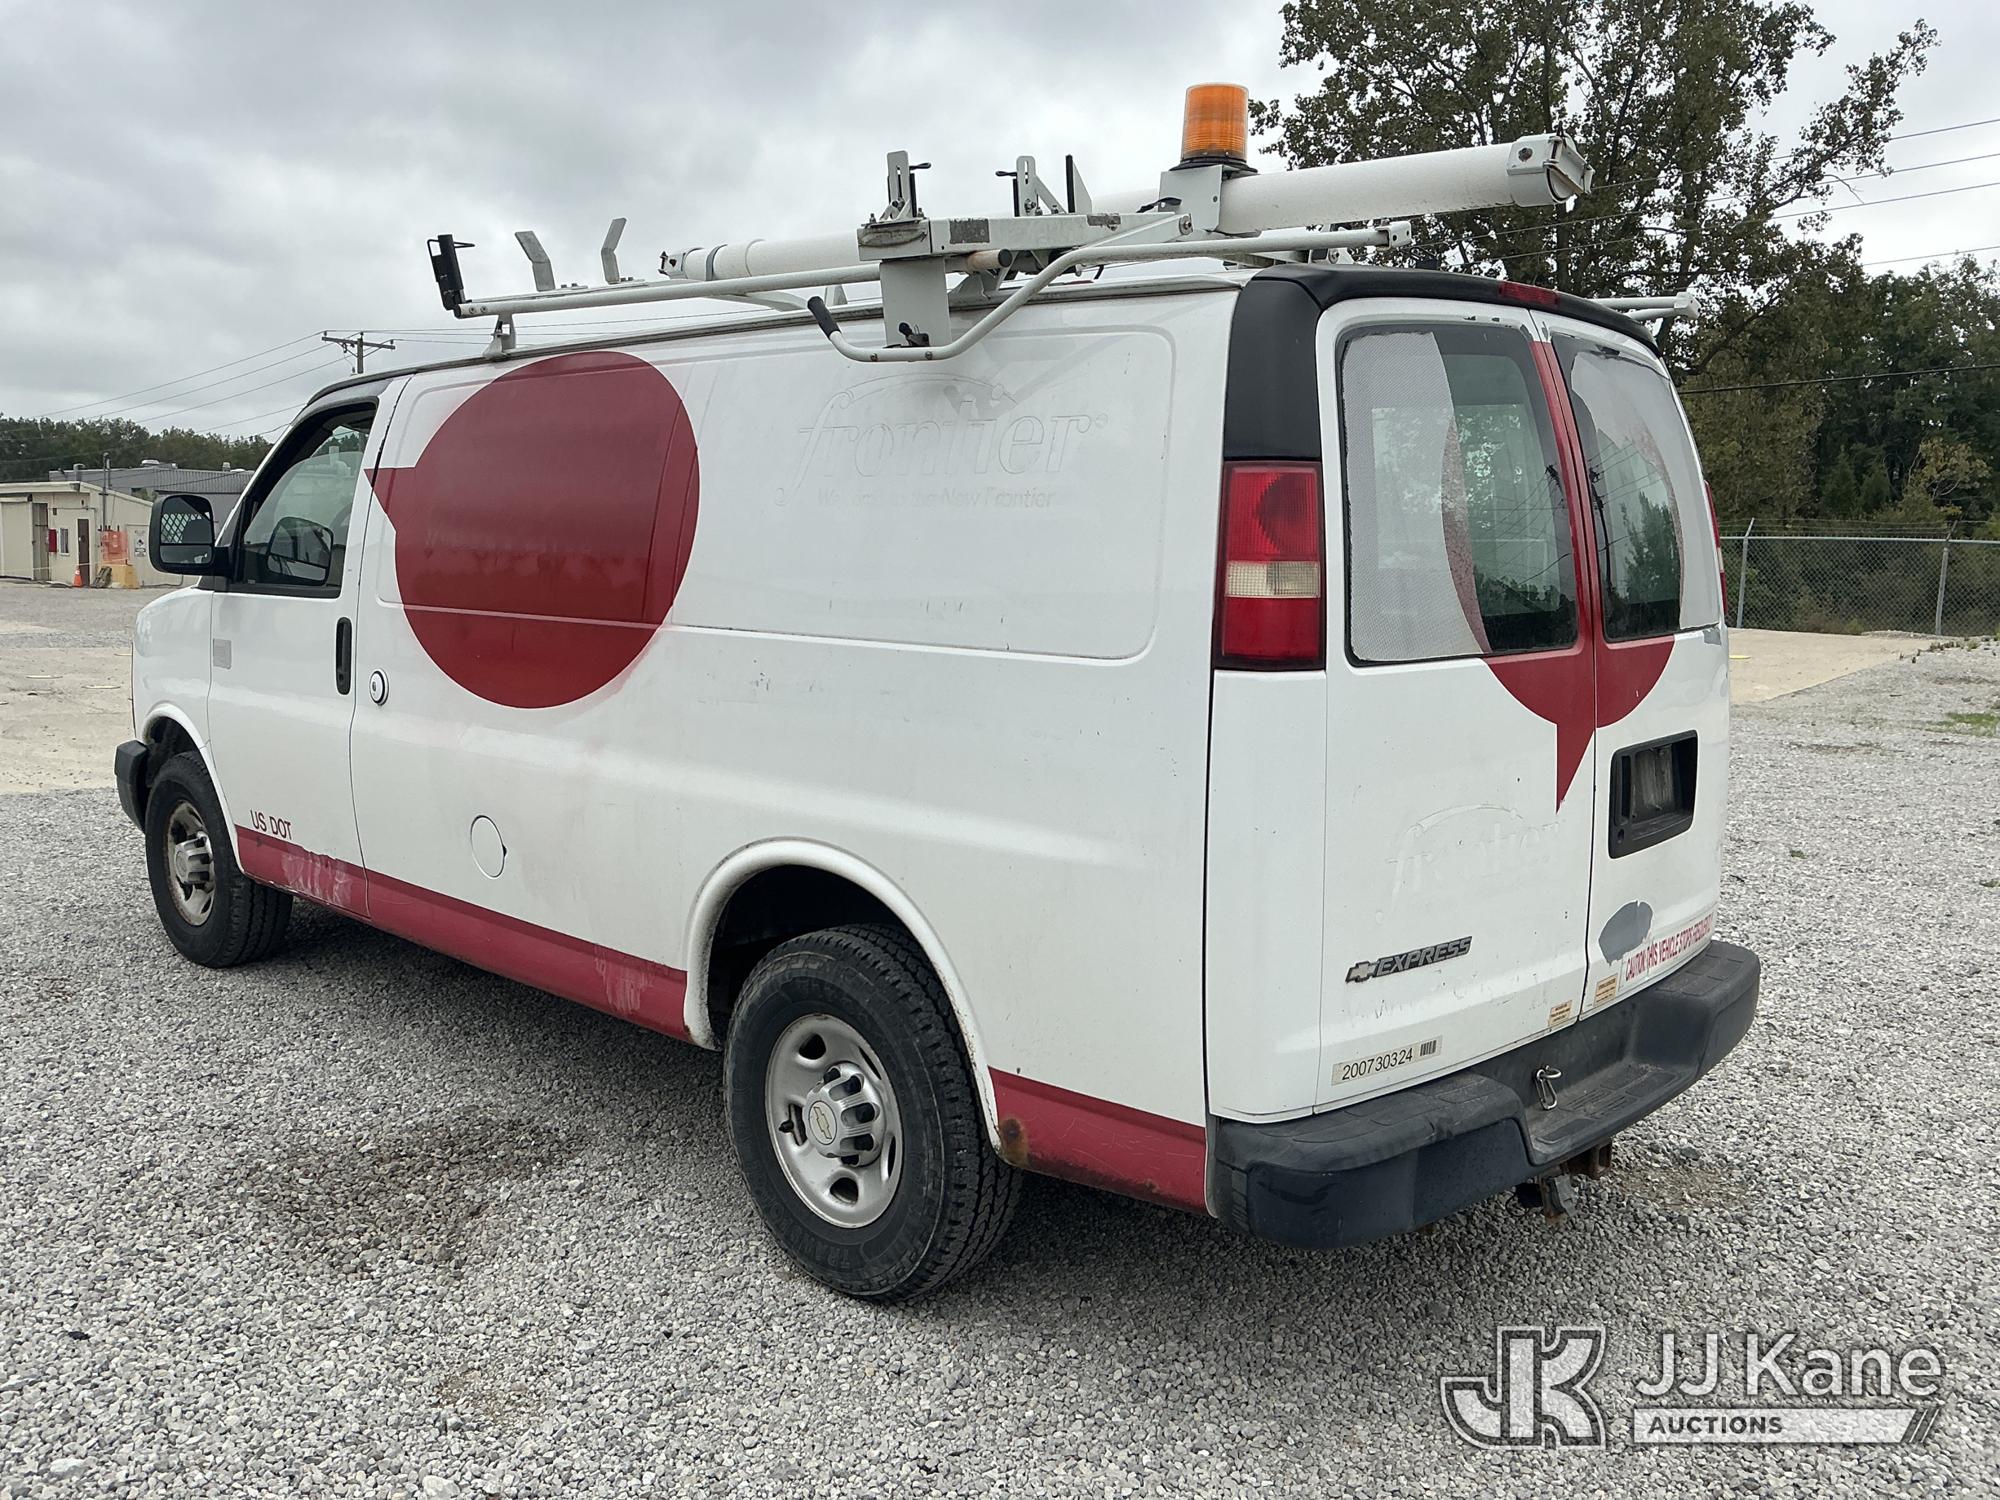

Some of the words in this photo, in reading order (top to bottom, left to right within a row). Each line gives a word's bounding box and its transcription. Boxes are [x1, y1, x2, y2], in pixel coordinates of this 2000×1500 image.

[250, 810, 267, 832] US
[269, 816, 292, 840] DOT
[1376, 937, 1471, 977] EXPRESS
[1342, 1048, 1413, 1080] 200730324
